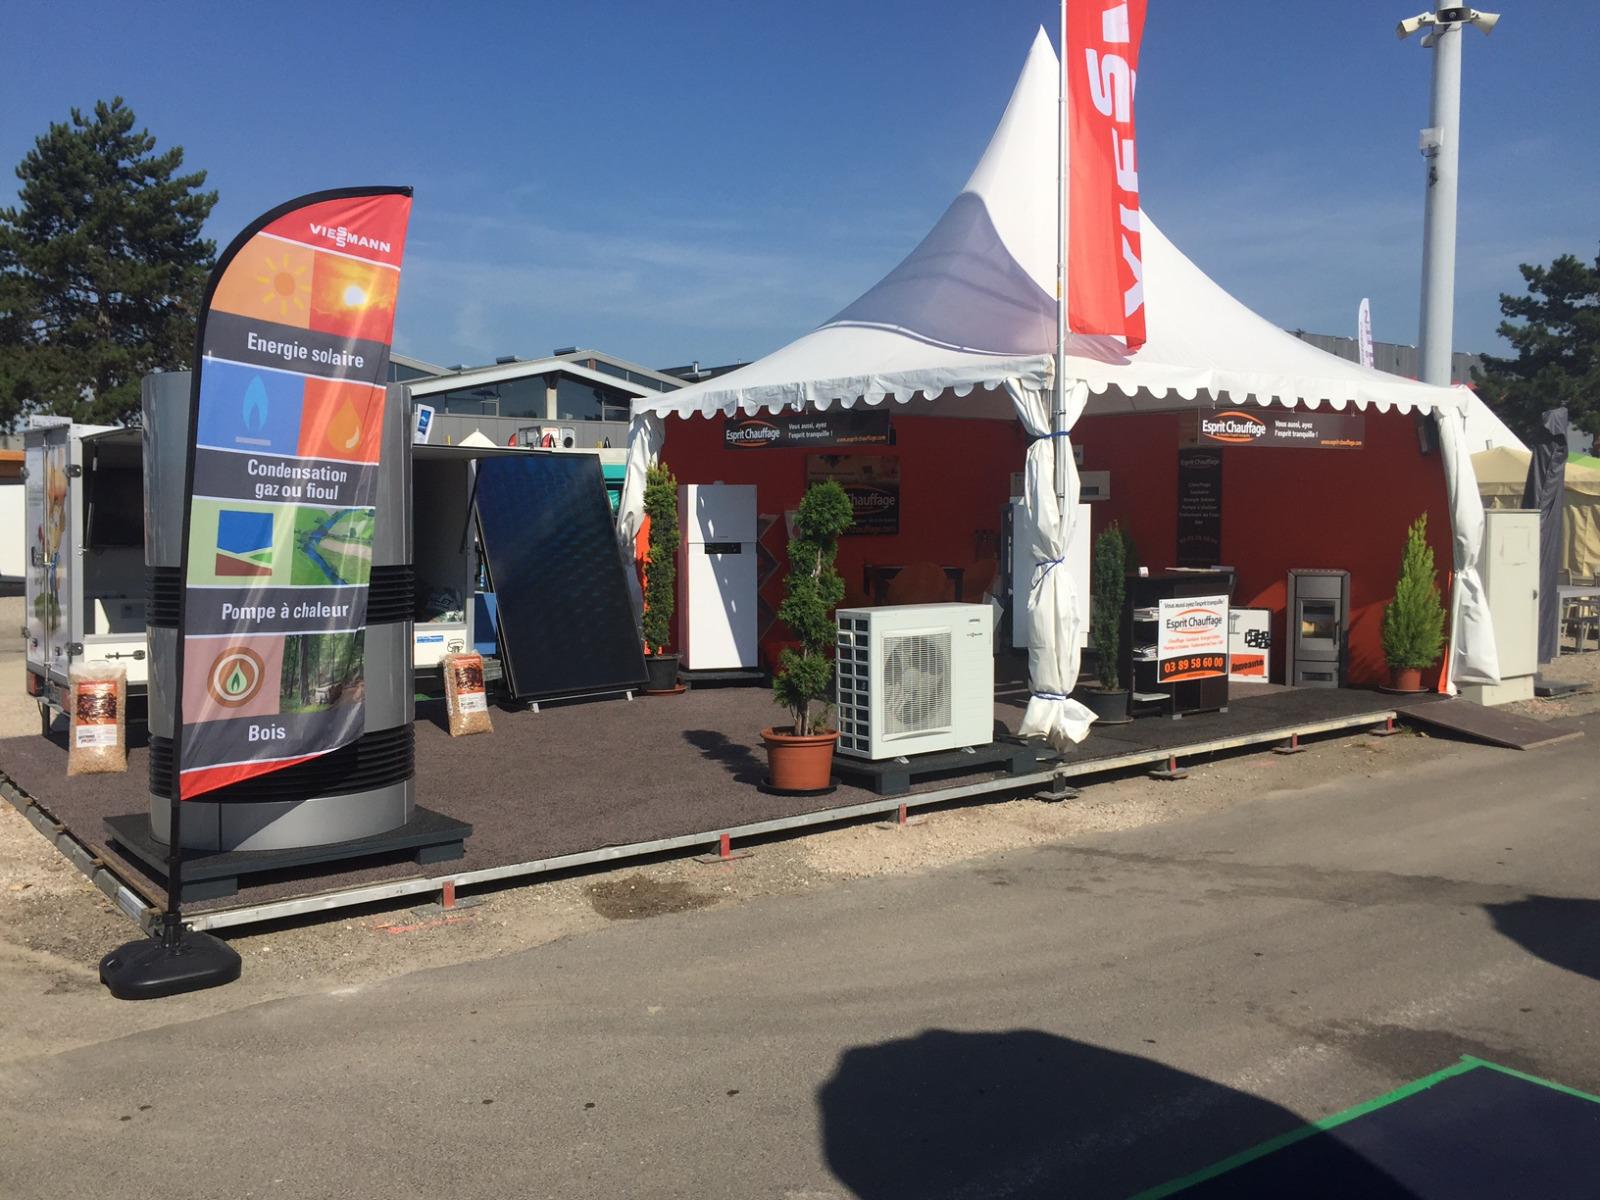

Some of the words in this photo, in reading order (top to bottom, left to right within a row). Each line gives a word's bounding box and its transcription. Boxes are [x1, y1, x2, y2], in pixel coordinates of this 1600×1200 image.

[310, 223, 391, 253] VIESSMANN
[247, 332, 308, 360] Energie
[311, 348, 364, 368] solaire
[726, 428, 744, 443] Esprit
[744, 427, 780, 441] Chauffage
[1202, 419, 1226, 435] Esprit
[1226, 420, 1266, 437] Chauffage
[247, 459, 347, 483] Condensation
[255, 483, 279, 499] gaz
[282, 485, 301, 497] ou
[306, 482, 339, 500] fioul
[222, 603, 276, 623] Pompe
[280, 602, 290, 619] à
[293, 602, 349, 619] chaleur
[1166, 618, 1188, 631] Esprit
[1188, 615, 1222, 627] Chauffage
[1164, 661, 1176, 673] 03
[1178, 659, 1189, 670] 89
[1191, 658, 1201, 668] 58
[1202, 657, 1213, 667] 60
[1214, 657, 1224, 667] 00
[248, 724, 286, 742] Bois
